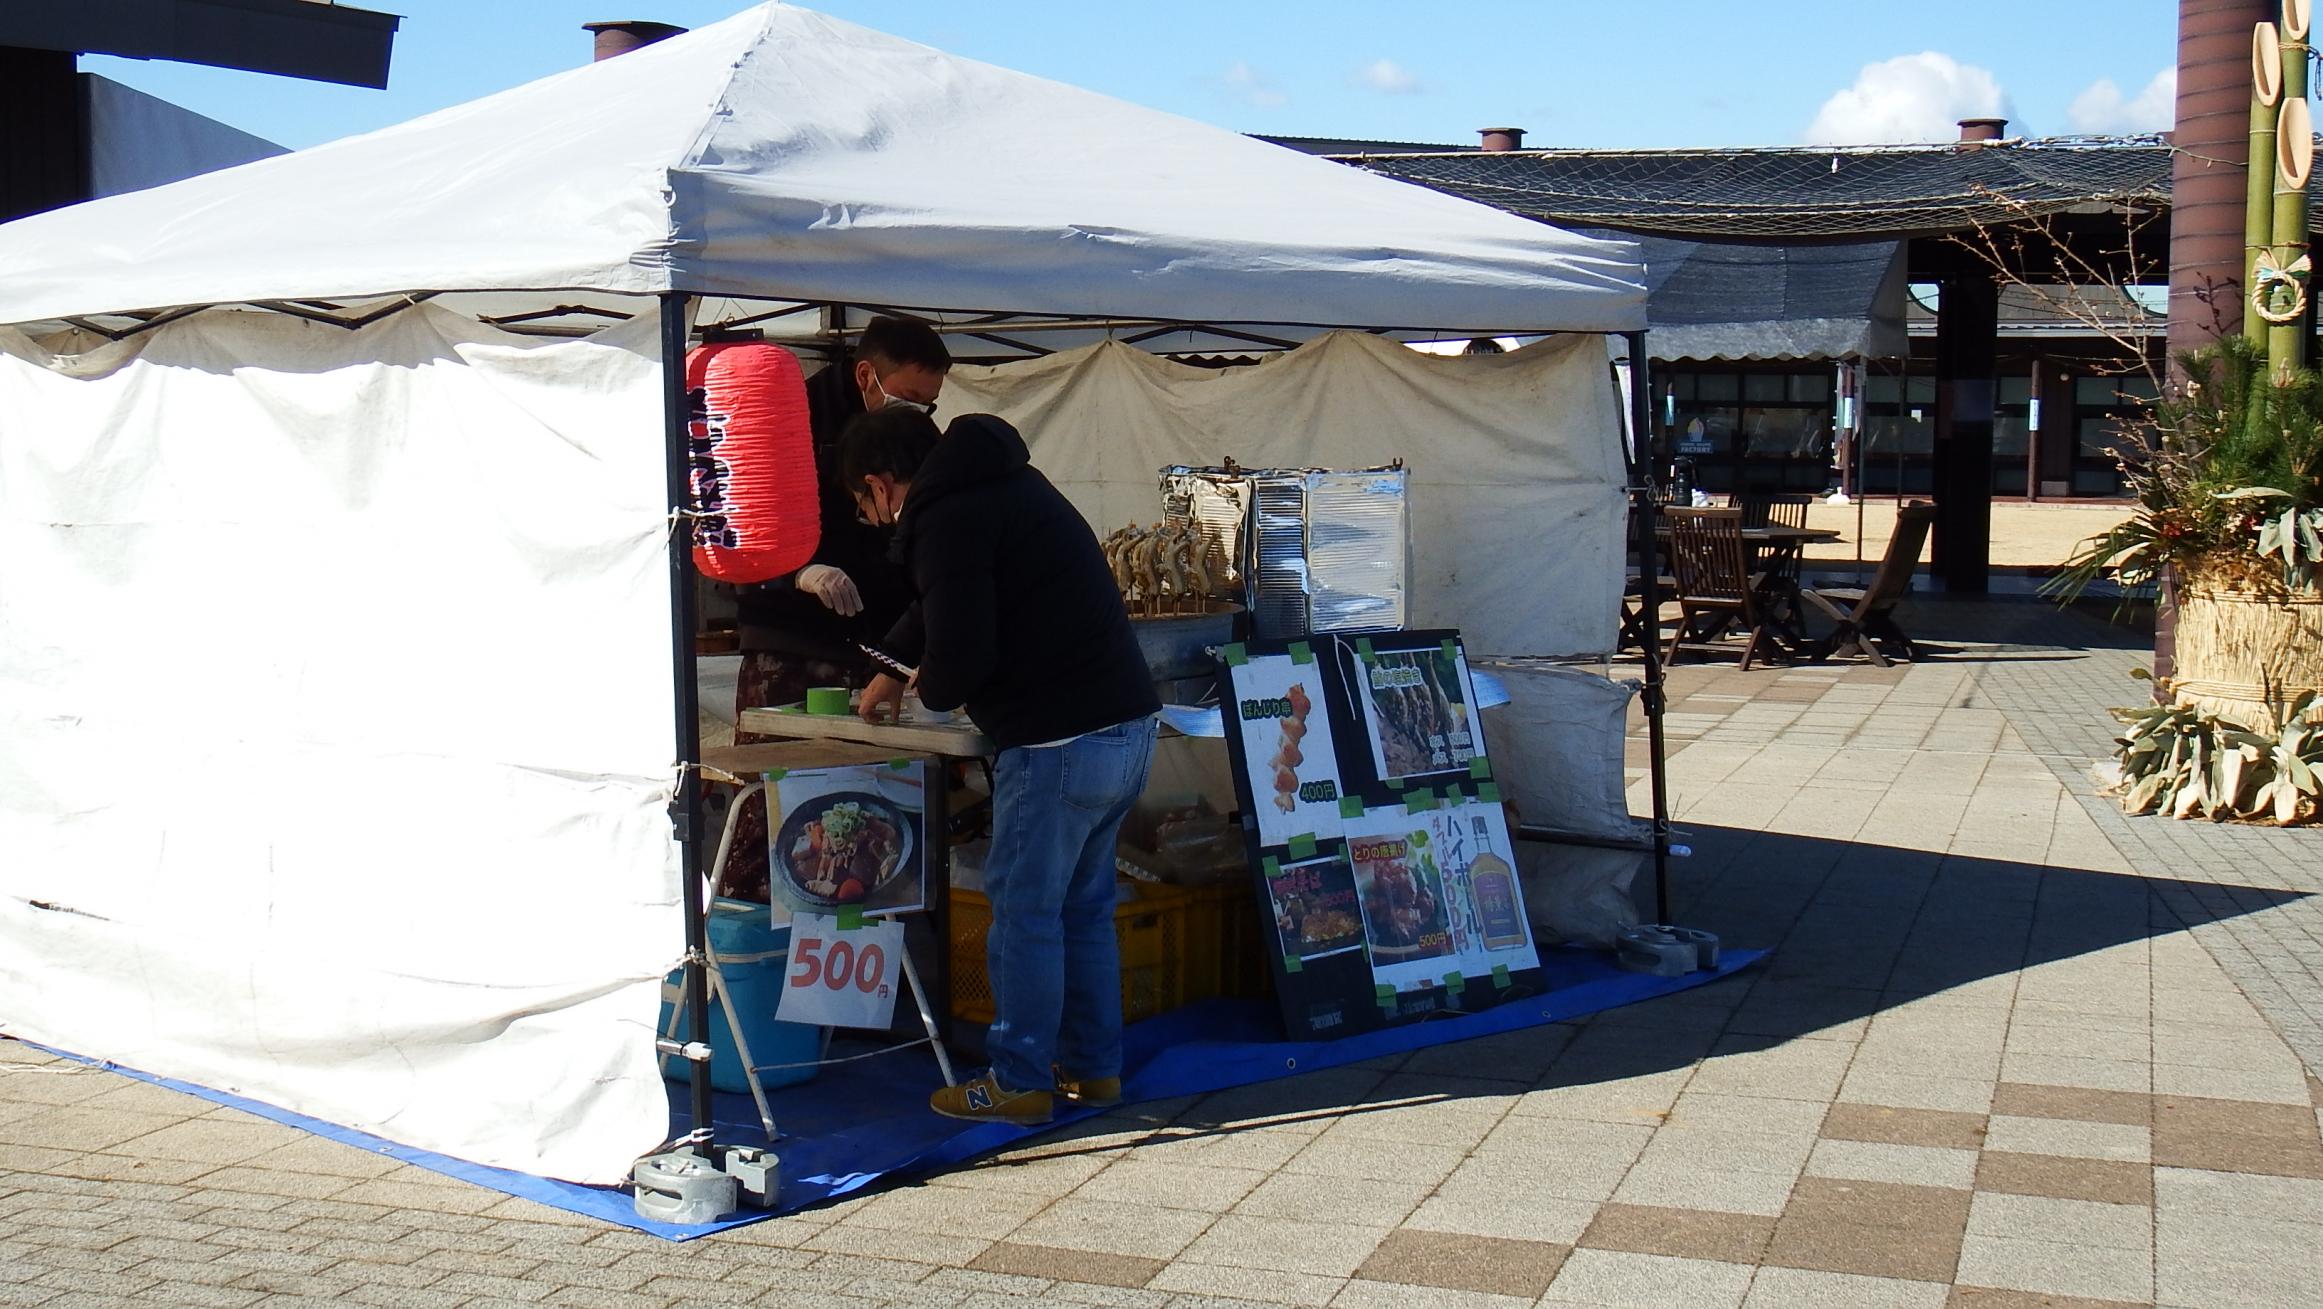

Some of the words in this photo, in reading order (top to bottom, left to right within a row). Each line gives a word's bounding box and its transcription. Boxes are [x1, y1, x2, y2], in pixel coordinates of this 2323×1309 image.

[1300, 780, 1338, 802] 400円
[1419, 932, 1448, 948] 500円
[966, 1085, 993, 1110] N
